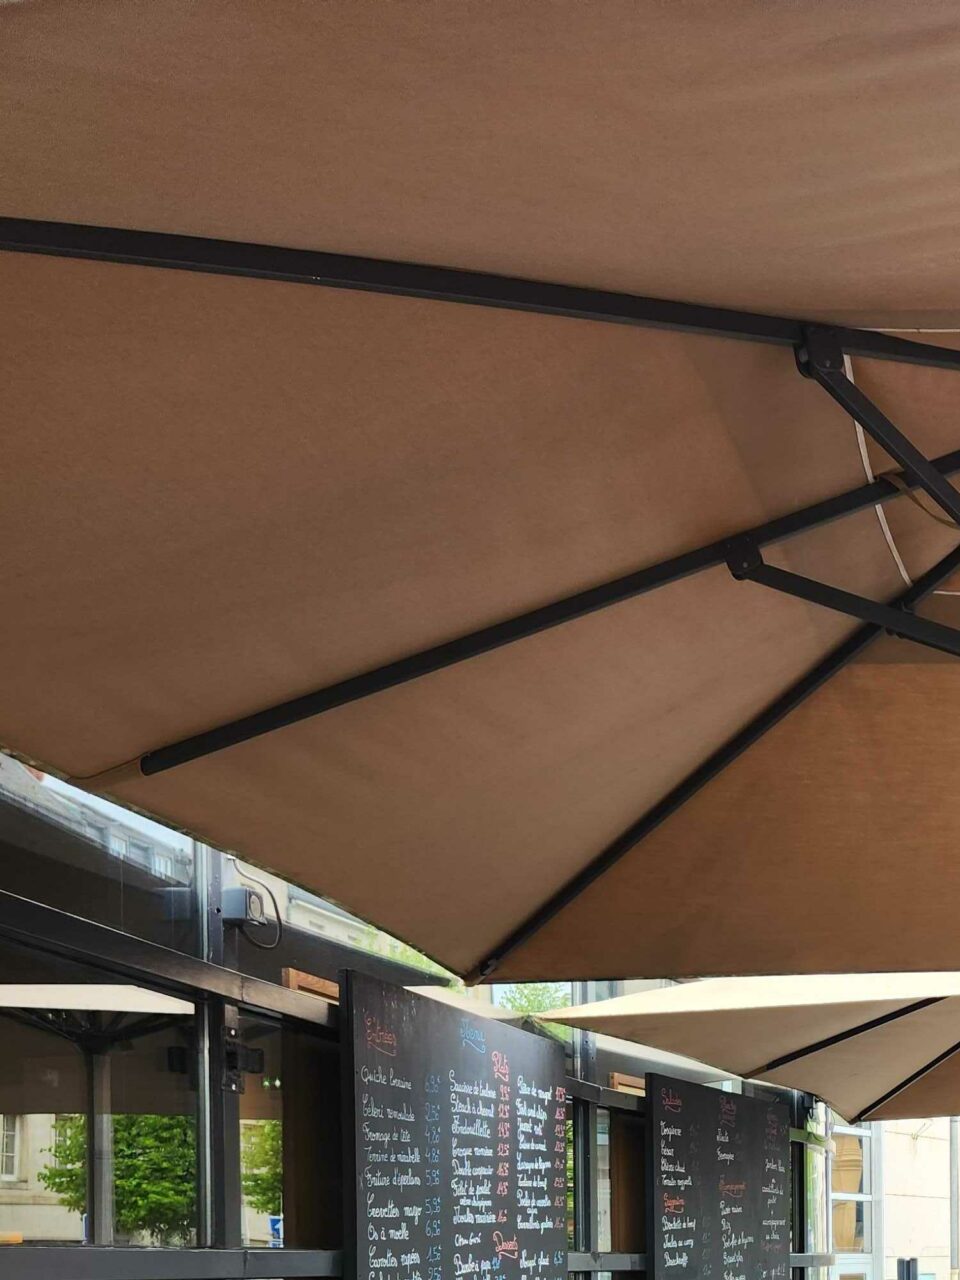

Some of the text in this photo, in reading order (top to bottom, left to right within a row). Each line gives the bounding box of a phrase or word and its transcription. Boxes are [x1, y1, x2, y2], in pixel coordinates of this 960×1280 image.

[361, 1065, 387, 1085] Quiche
[362, 1122, 391, 1149] Fromage
[392, 1126, 399, 1141] de
[364, 1146, 388, 1162] Terrine
[389, 1147, 396, 1162] de
